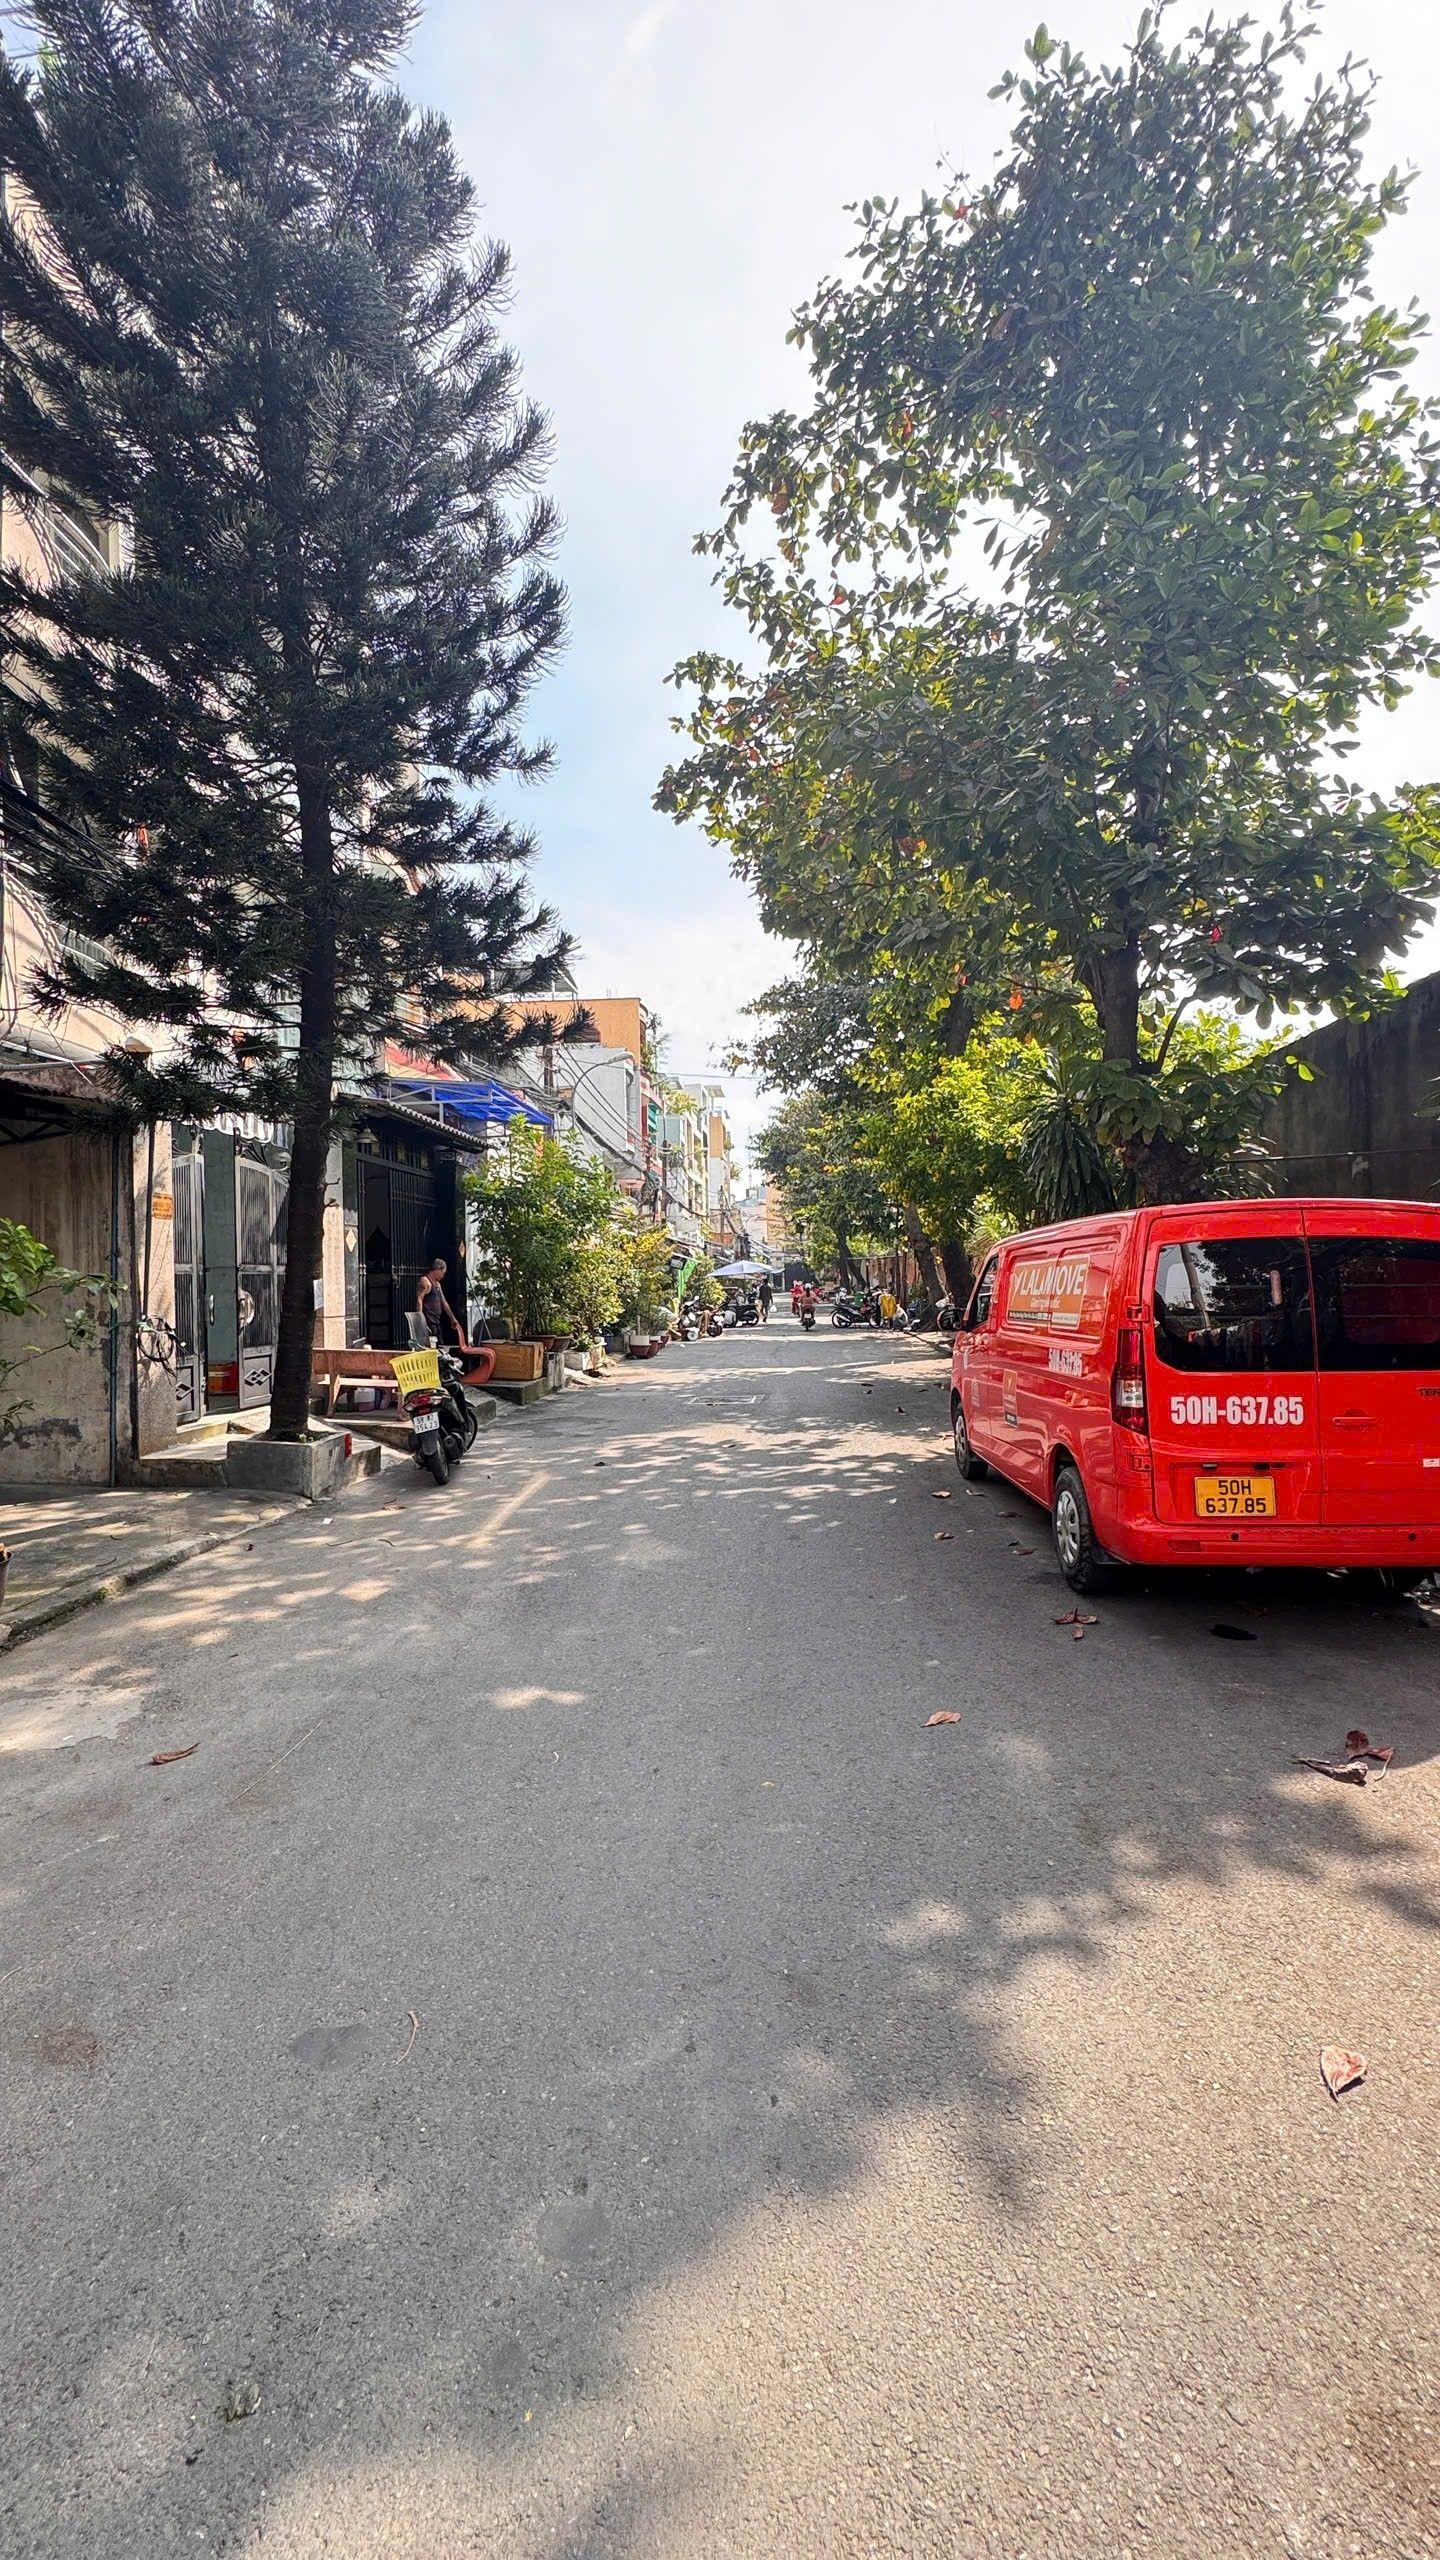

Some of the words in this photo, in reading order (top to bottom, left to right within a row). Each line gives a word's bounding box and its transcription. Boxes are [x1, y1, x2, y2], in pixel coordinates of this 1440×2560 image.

[1170, 1396, 1304, 1425] 50H-637.85
[1218, 1480, 1252, 1495] 50H
[1205, 1497, 1267, 1513] 637.85
